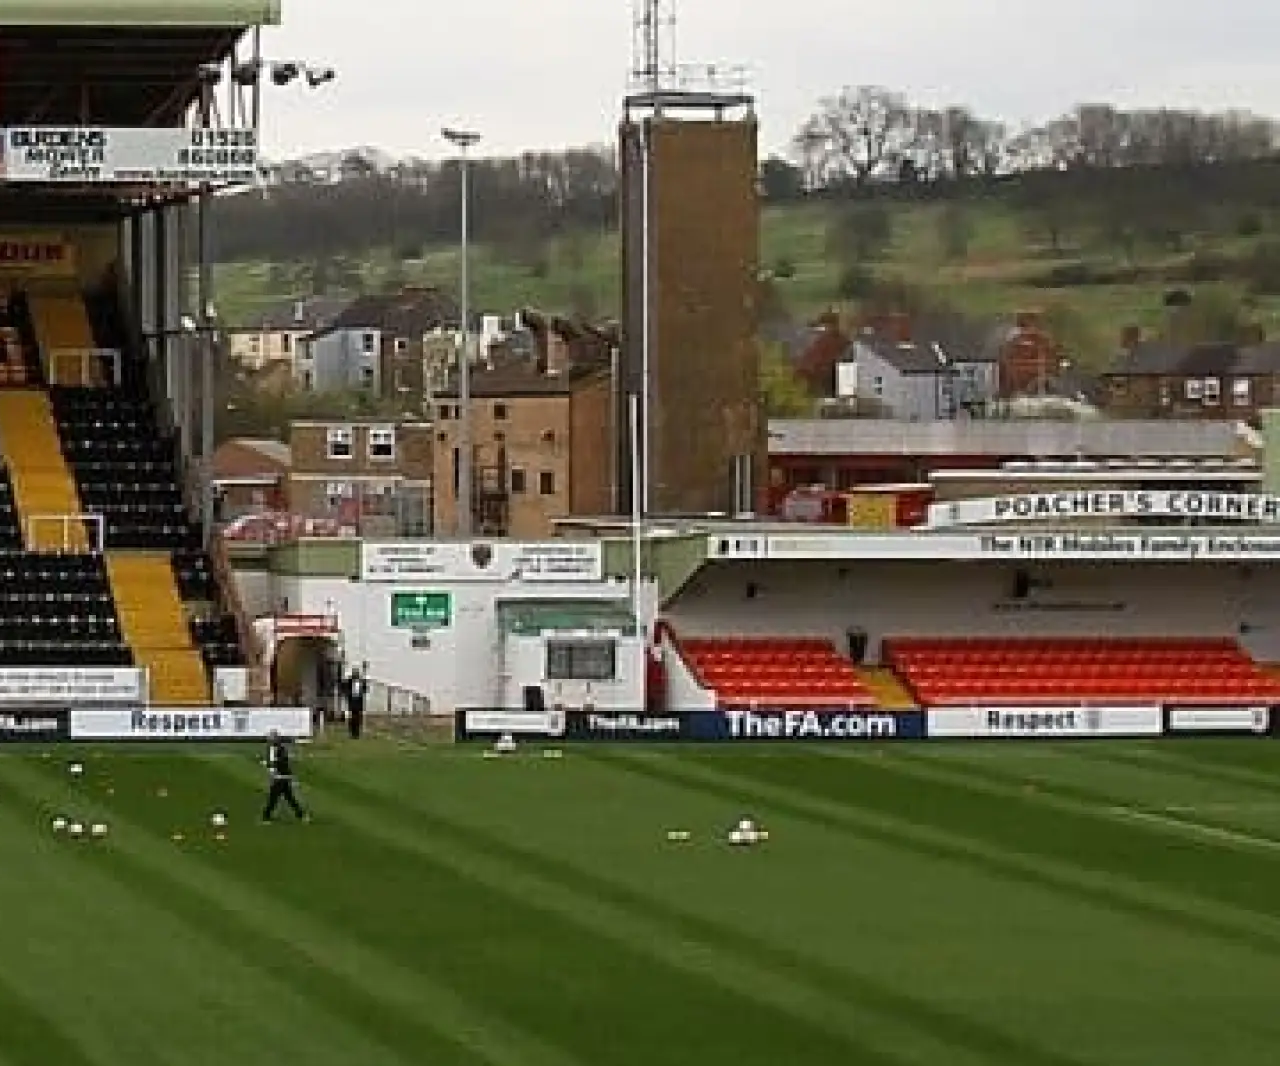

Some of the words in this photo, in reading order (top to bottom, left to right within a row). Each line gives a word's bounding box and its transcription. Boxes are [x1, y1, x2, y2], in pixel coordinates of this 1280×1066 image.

[994, 493, 1153, 518] POACHER'S
[1166, 493, 1278, 517] CORNER
[130, 710, 222, 737] Respect
[726, 710, 897, 737] TheFA.com
[986, 709, 1077, 735] Respect
